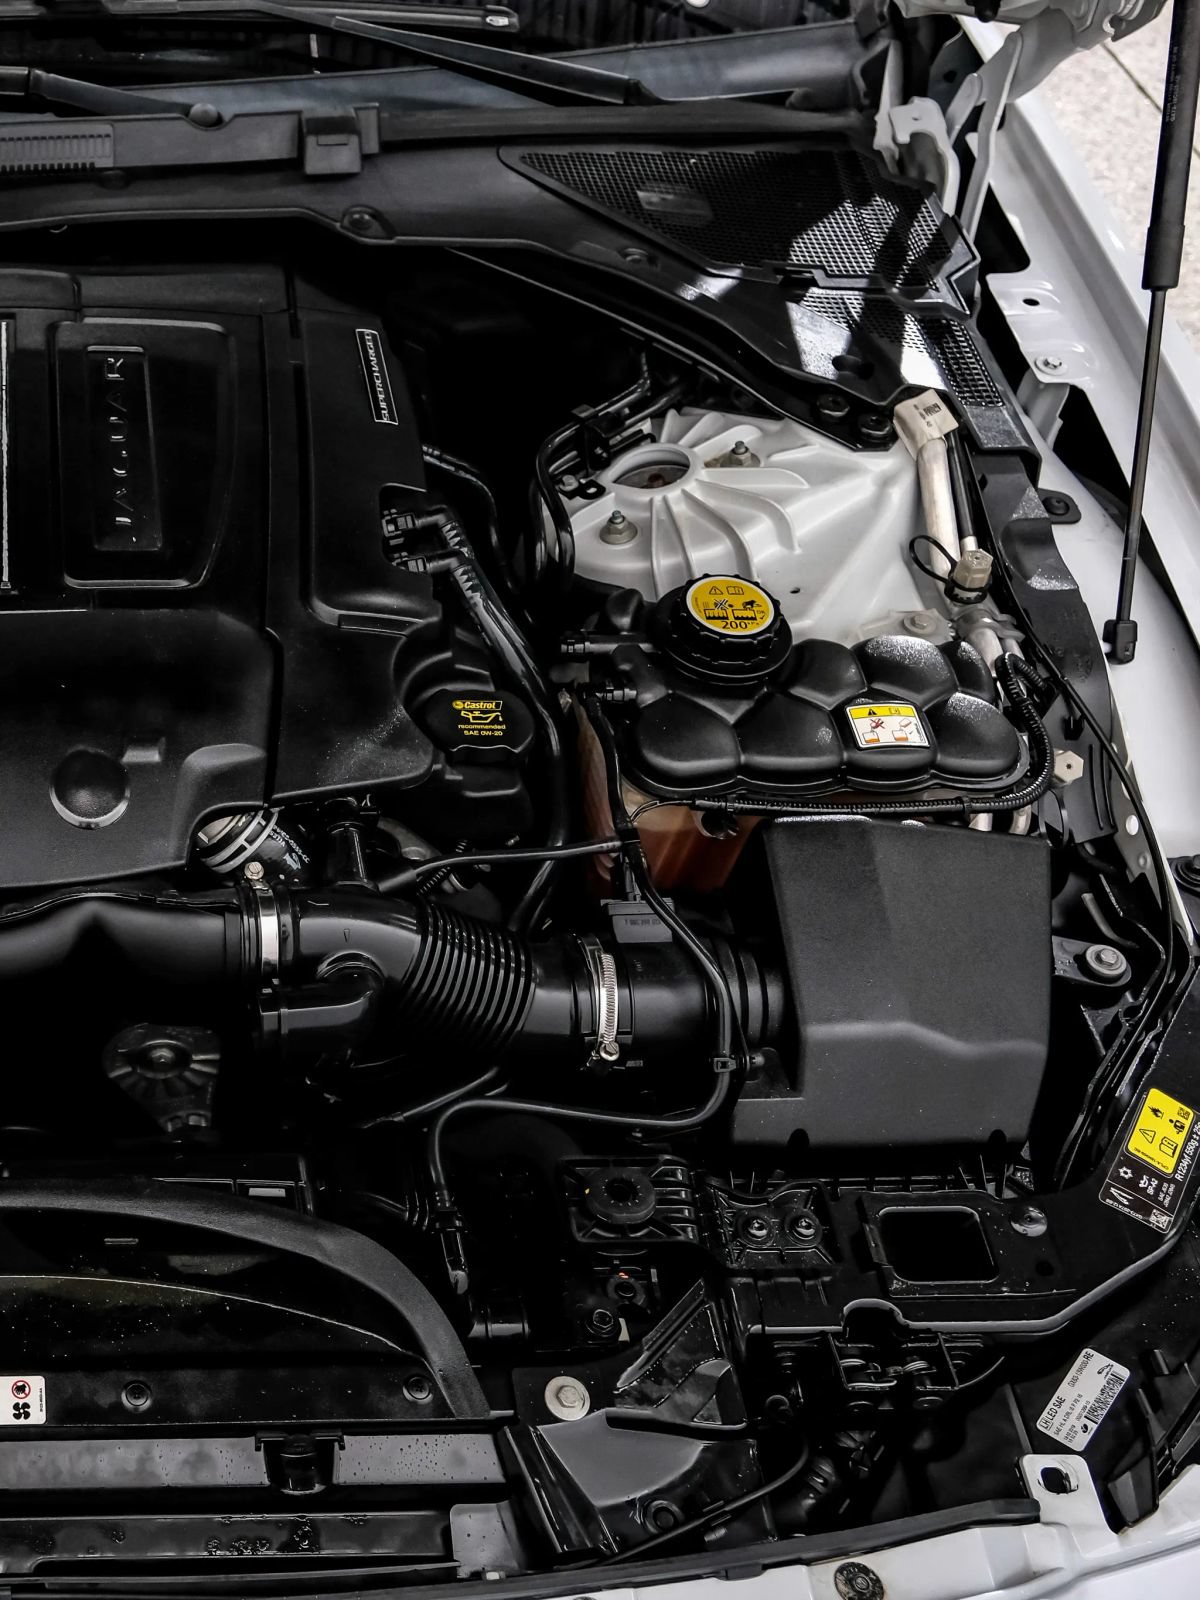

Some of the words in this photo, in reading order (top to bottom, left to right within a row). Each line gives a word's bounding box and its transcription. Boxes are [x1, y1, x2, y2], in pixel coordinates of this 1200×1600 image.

[364, 331, 390, 421] SUPERCHARGED
[104, 357, 137, 543] JAGUAR
[721, 620, 748, 630] 200
[464, 701, 496, 709] Castrol
[1175, 1153, 1192, 1182] R1234yf
[1185, 1139, 1199, 1156] 550g
[1053, 1395, 1066, 1409] SAE
[1045, 1407, 1058, 1421] LED
[1040, 1417, 1052, 1430] LH
